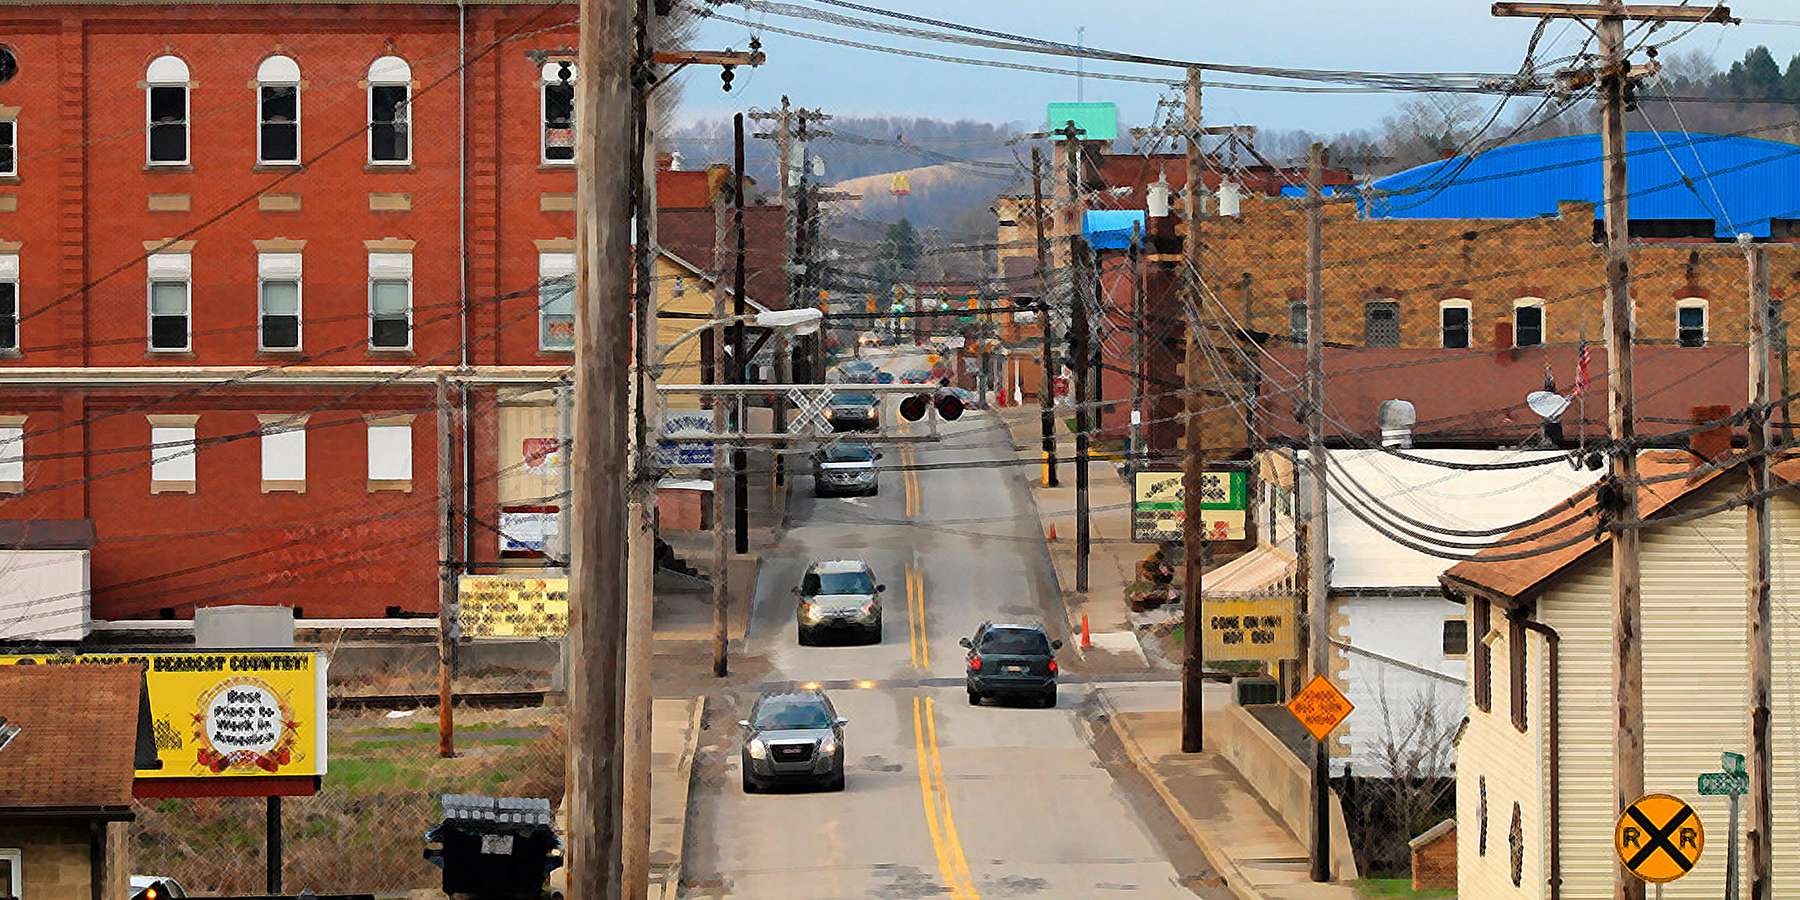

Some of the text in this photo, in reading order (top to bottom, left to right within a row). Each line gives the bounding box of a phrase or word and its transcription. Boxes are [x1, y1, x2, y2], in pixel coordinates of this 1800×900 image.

[1210, 616, 1239, 629] COME
[153, 655, 227, 672] BEARCAT
[229, 655, 309, 671] COUNTRY!
[227, 690, 261, 703] Best
[213, 705, 275, 717] Place to
[216, 718, 271, 731] Work in
[213, 731, 274, 746] America
[1623, 827, 1698, 848] R R
